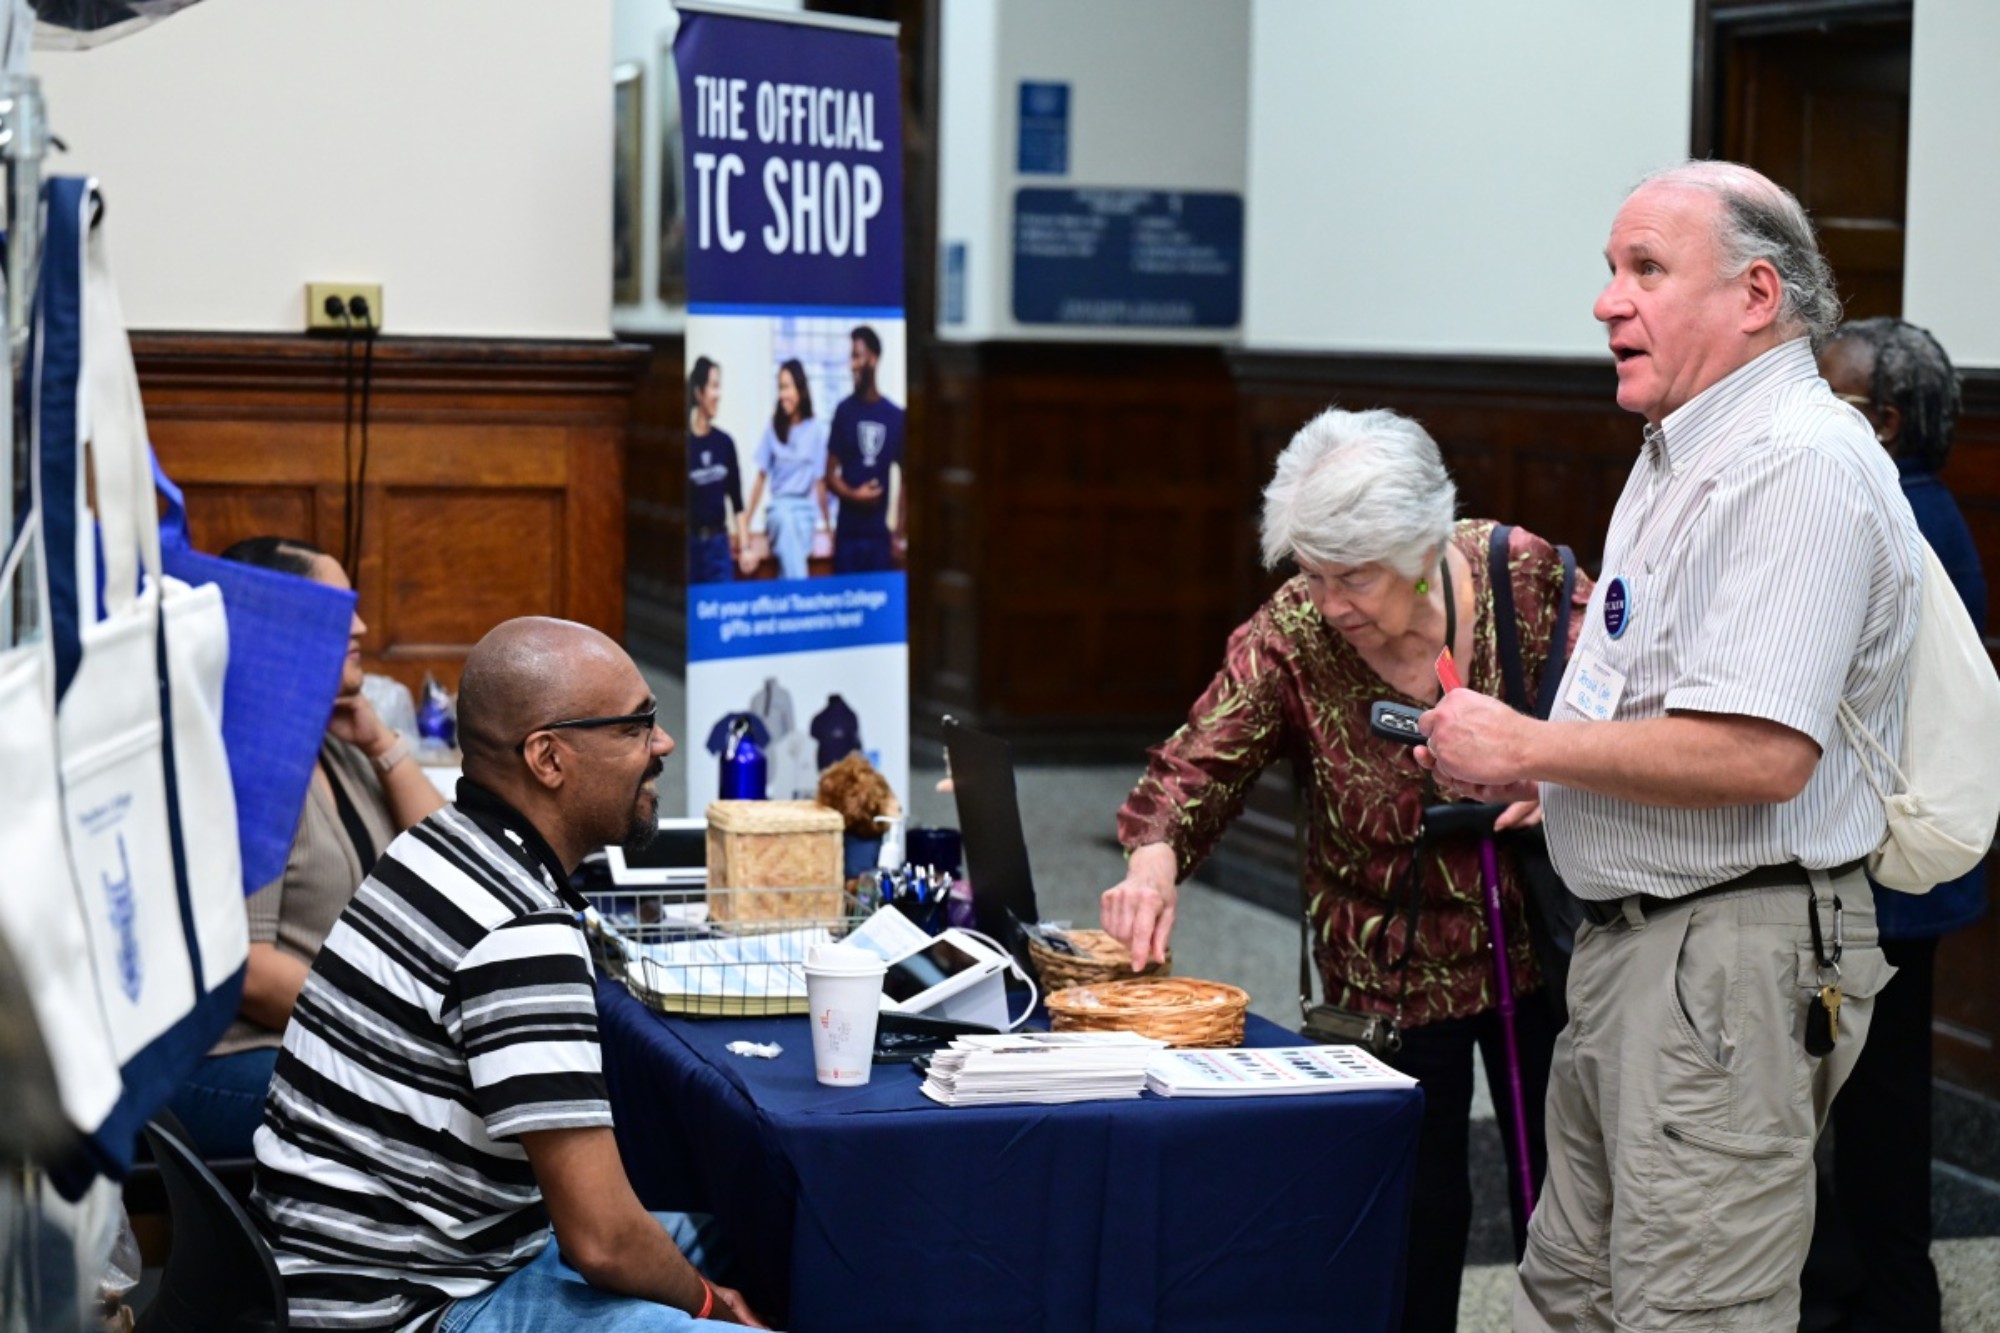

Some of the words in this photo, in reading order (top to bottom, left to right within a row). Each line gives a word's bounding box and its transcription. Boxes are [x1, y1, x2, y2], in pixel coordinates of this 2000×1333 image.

[695, 75, 748, 141] THE
[756, 81, 884, 152] OFFICIAL
[693, 152, 746, 252] TC
[763, 156, 883, 257] SHOP
[696, 600, 719, 620] Get
[720, 601, 749, 621] your
[750, 595, 789, 616] official
[790, 593, 843, 613] Teachers
[843, 589, 887, 611] College
[719, 618, 751, 643] gifts
[752, 615, 776, 636] and
